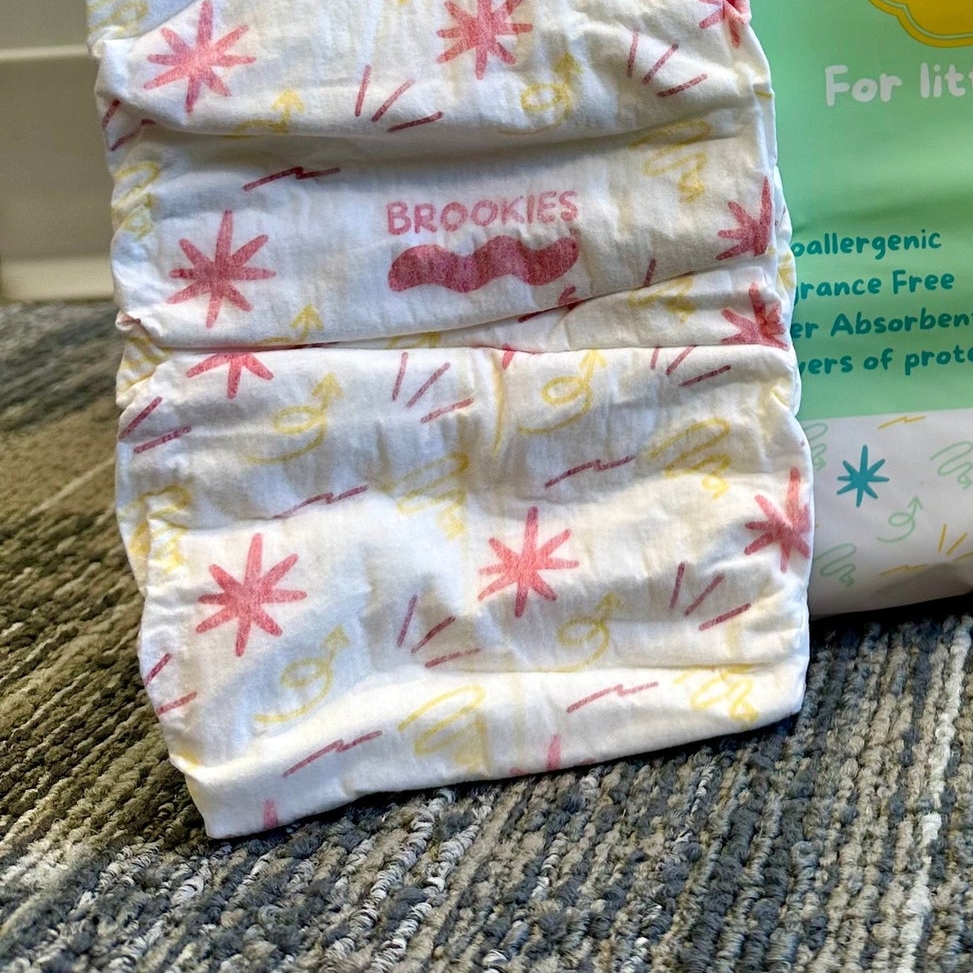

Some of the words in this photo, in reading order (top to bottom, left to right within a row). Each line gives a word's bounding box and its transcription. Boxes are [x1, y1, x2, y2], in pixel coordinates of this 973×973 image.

[824, 64, 902, 106] For
[386, 190, 579, 236] BROOKIES
[892, 269, 955, 295] Free
[863, 348, 894, 371] of
